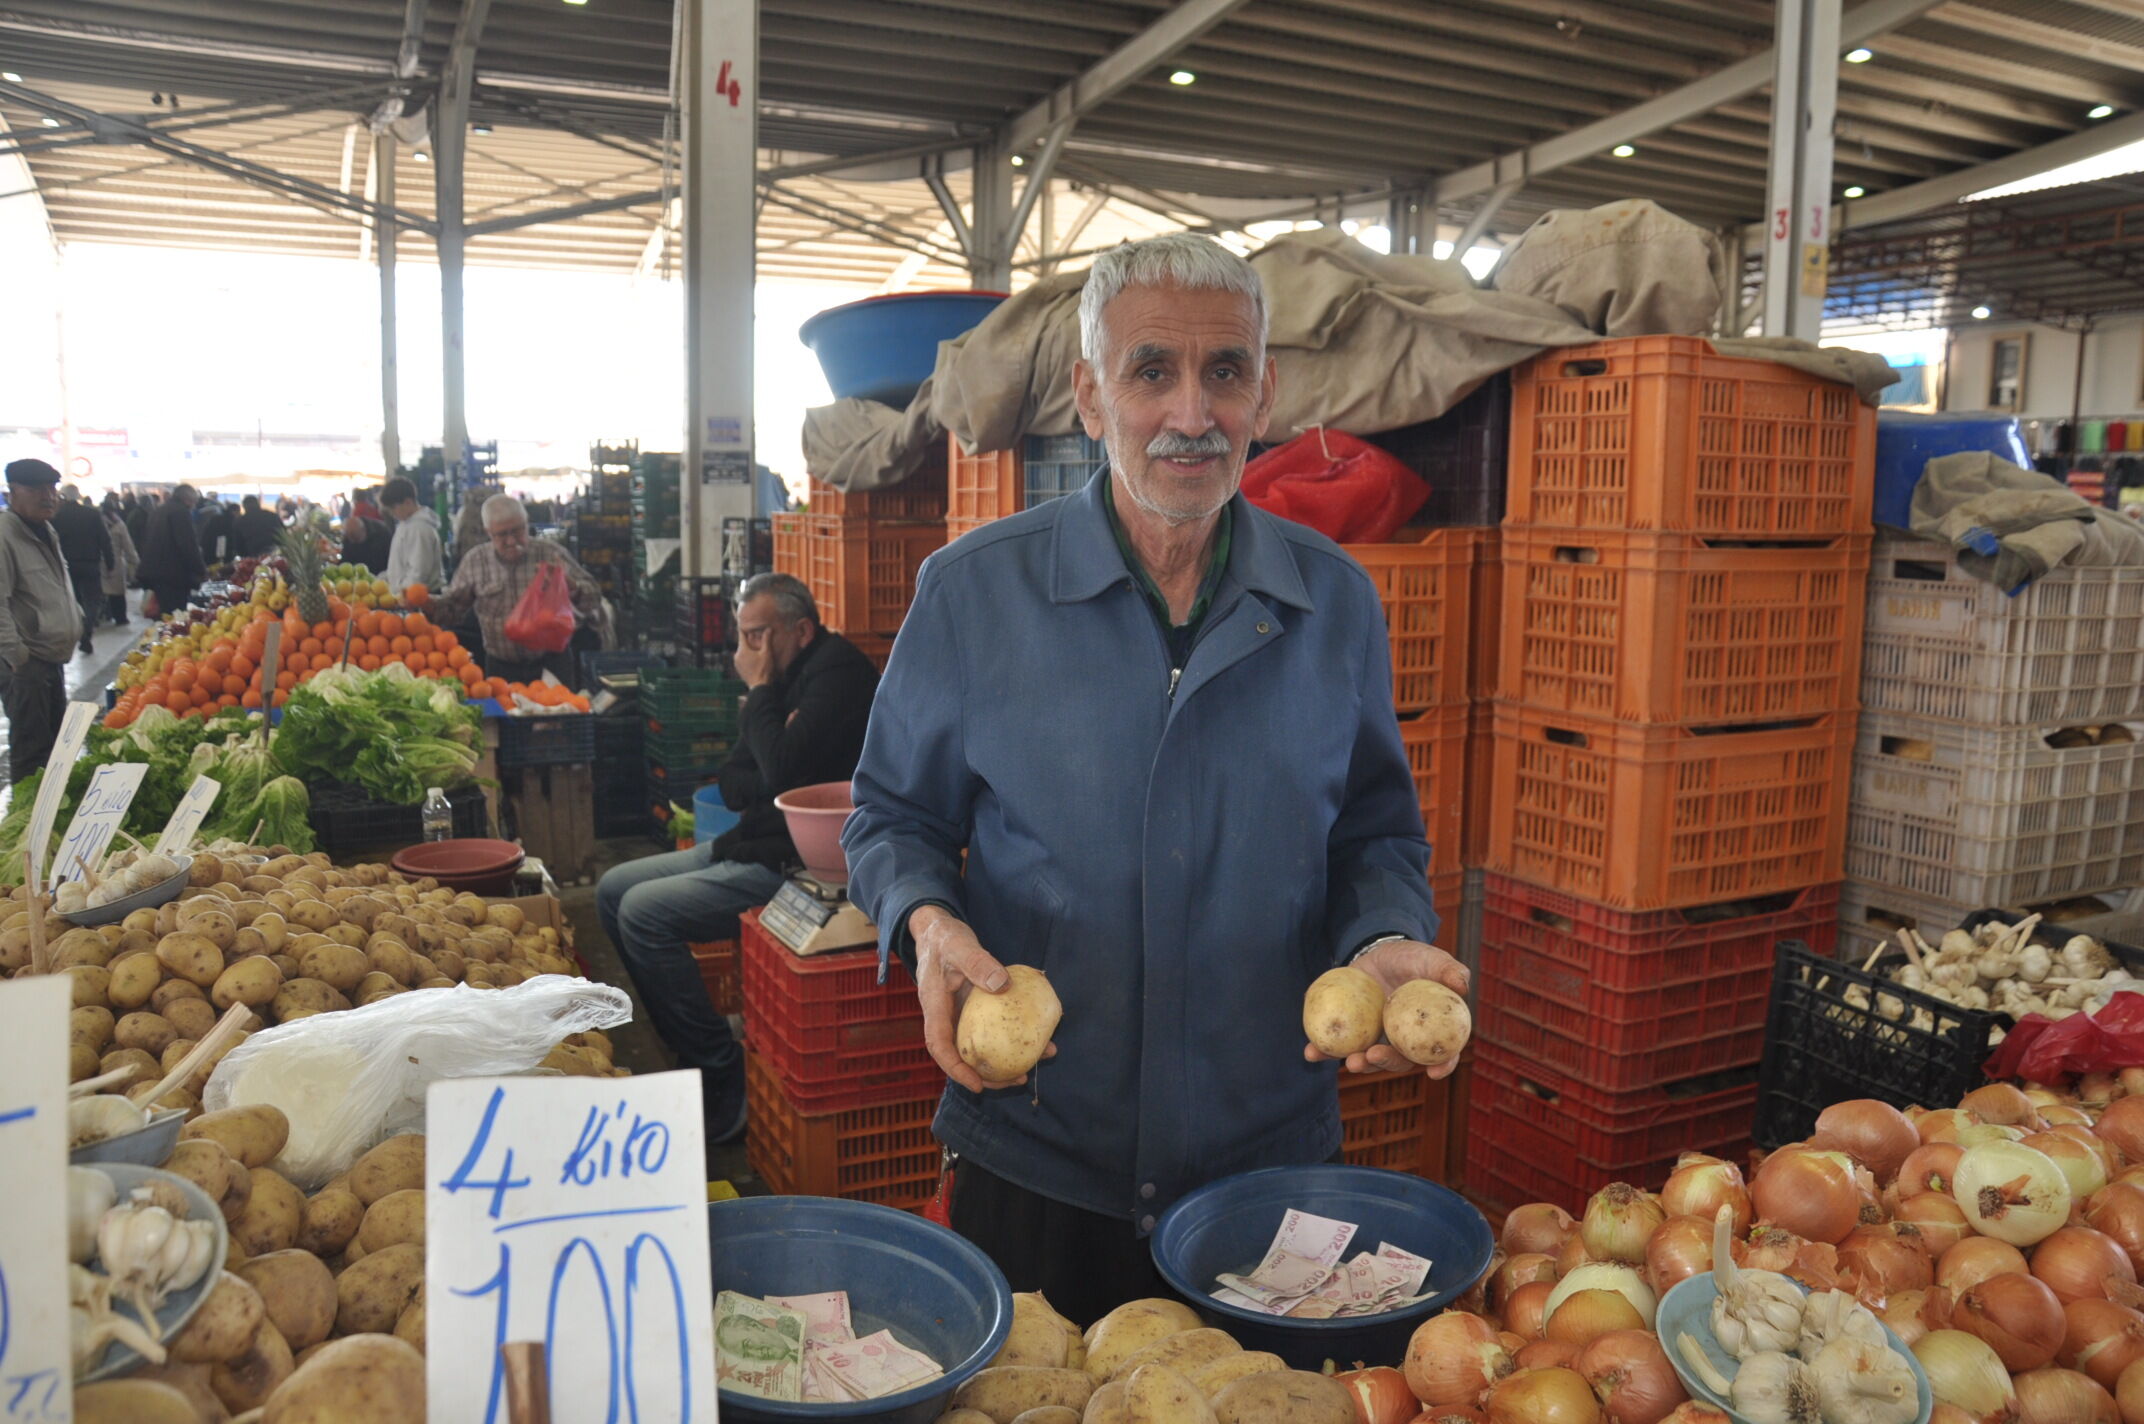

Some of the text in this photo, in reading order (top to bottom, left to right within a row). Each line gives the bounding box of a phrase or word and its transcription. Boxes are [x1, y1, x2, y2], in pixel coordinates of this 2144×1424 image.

[716, 60, 740, 108] 4
[1775, 209, 1788, 240] 3
[1811, 206, 1822, 238] 3
[79, 770, 115, 817] 5
[440, 1086, 531, 1219] 4
[1285, 1213, 1300, 1233] 200
[1328, 1224, 1352, 1251] 200
[1269, 1254, 1286, 1269] 200
[1296, 1270, 1326, 1290] 200
[449, 1232, 691, 1424] 100
